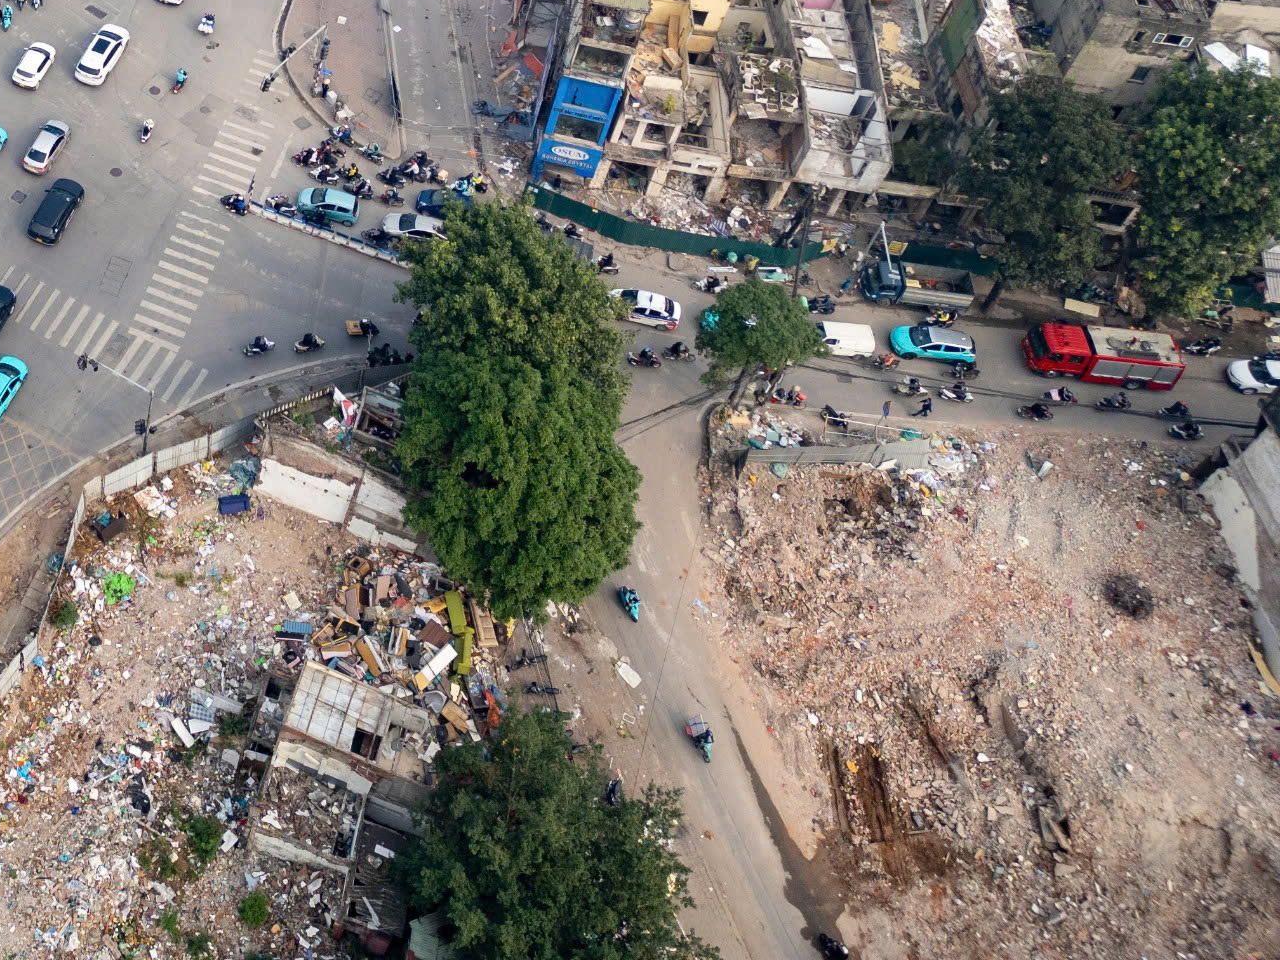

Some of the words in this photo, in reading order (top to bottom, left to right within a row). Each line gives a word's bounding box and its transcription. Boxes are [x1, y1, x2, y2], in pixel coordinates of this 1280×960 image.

[553, 147, 588, 159] OSUM
[542, 153, 567, 163] BOHEMIA
[567, 159, 592, 169] CRYSTAL
